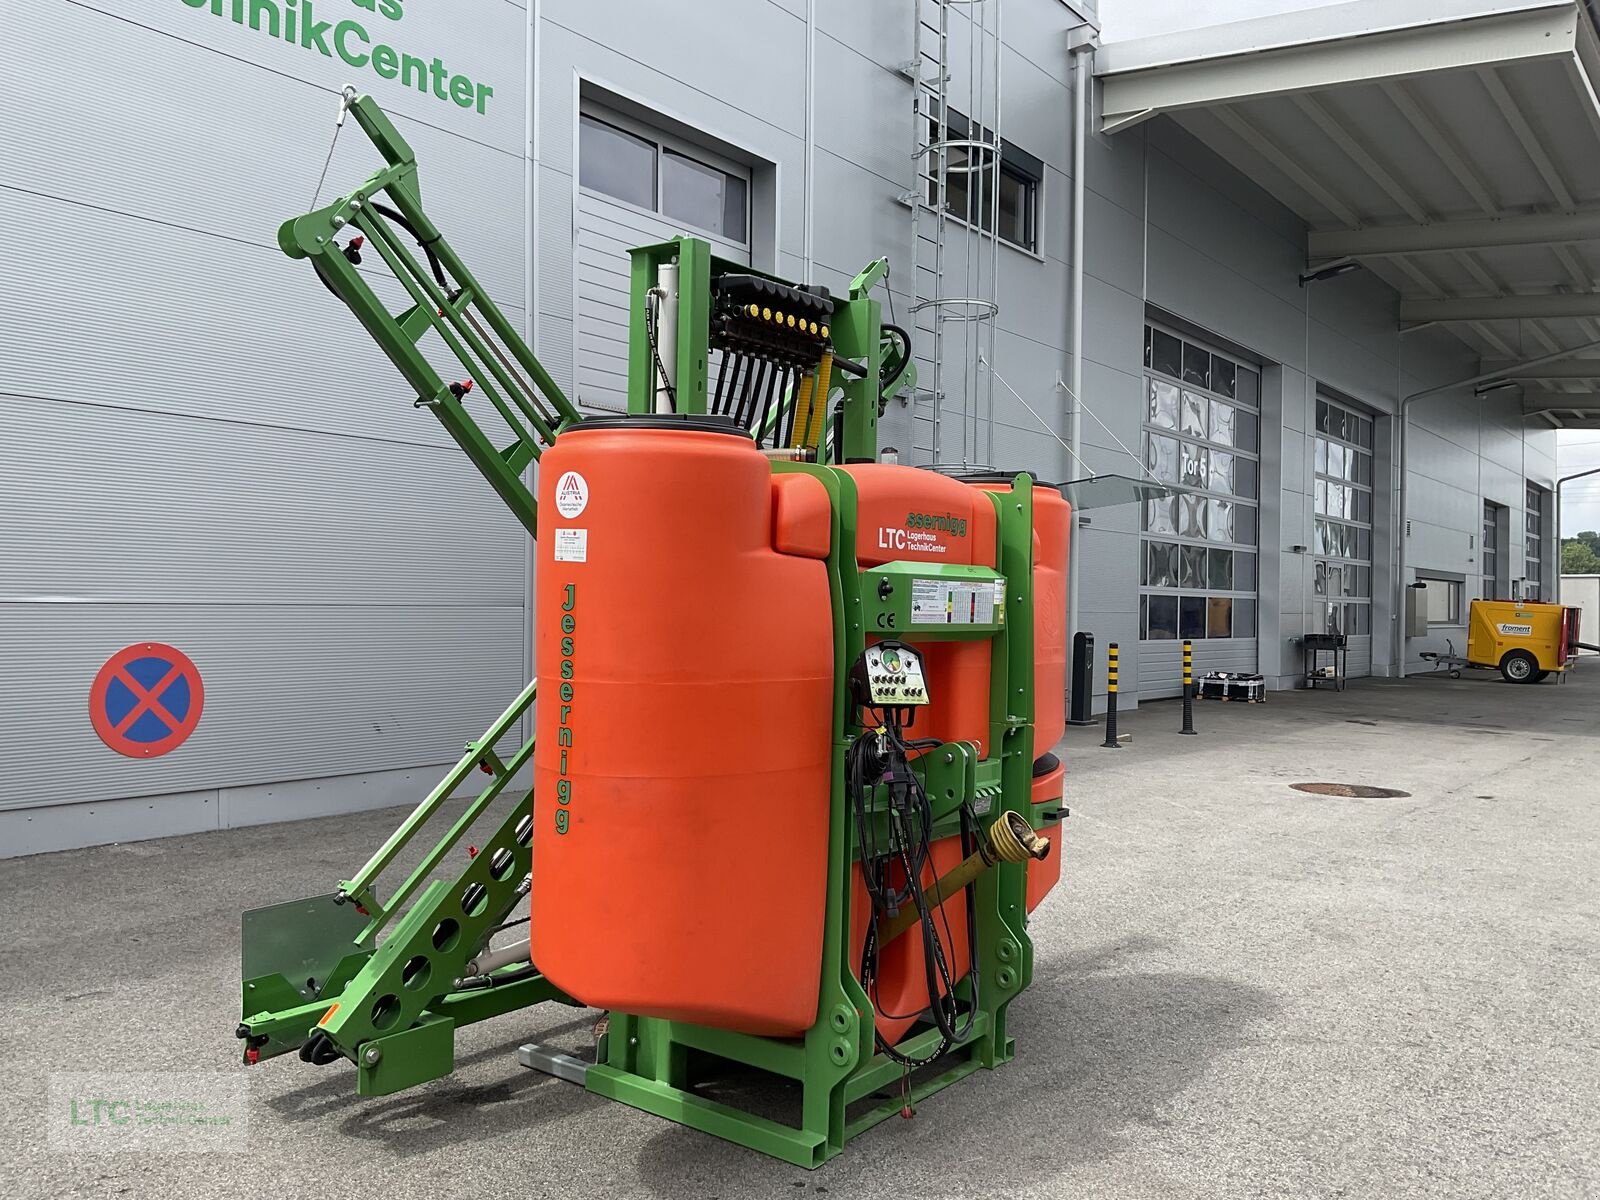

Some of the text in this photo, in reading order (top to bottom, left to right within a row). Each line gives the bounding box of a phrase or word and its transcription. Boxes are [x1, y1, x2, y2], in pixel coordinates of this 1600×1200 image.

[1182, 453, 1206, 477] Tor 5
[878, 527, 906, 550] LTC
[907, 531, 936, 541] Lagerhaus
[907, 542, 946, 553] TechnikCenter
[1501, 623, 1531, 632] froment
[555, 583, 576, 835] Jessernigg
